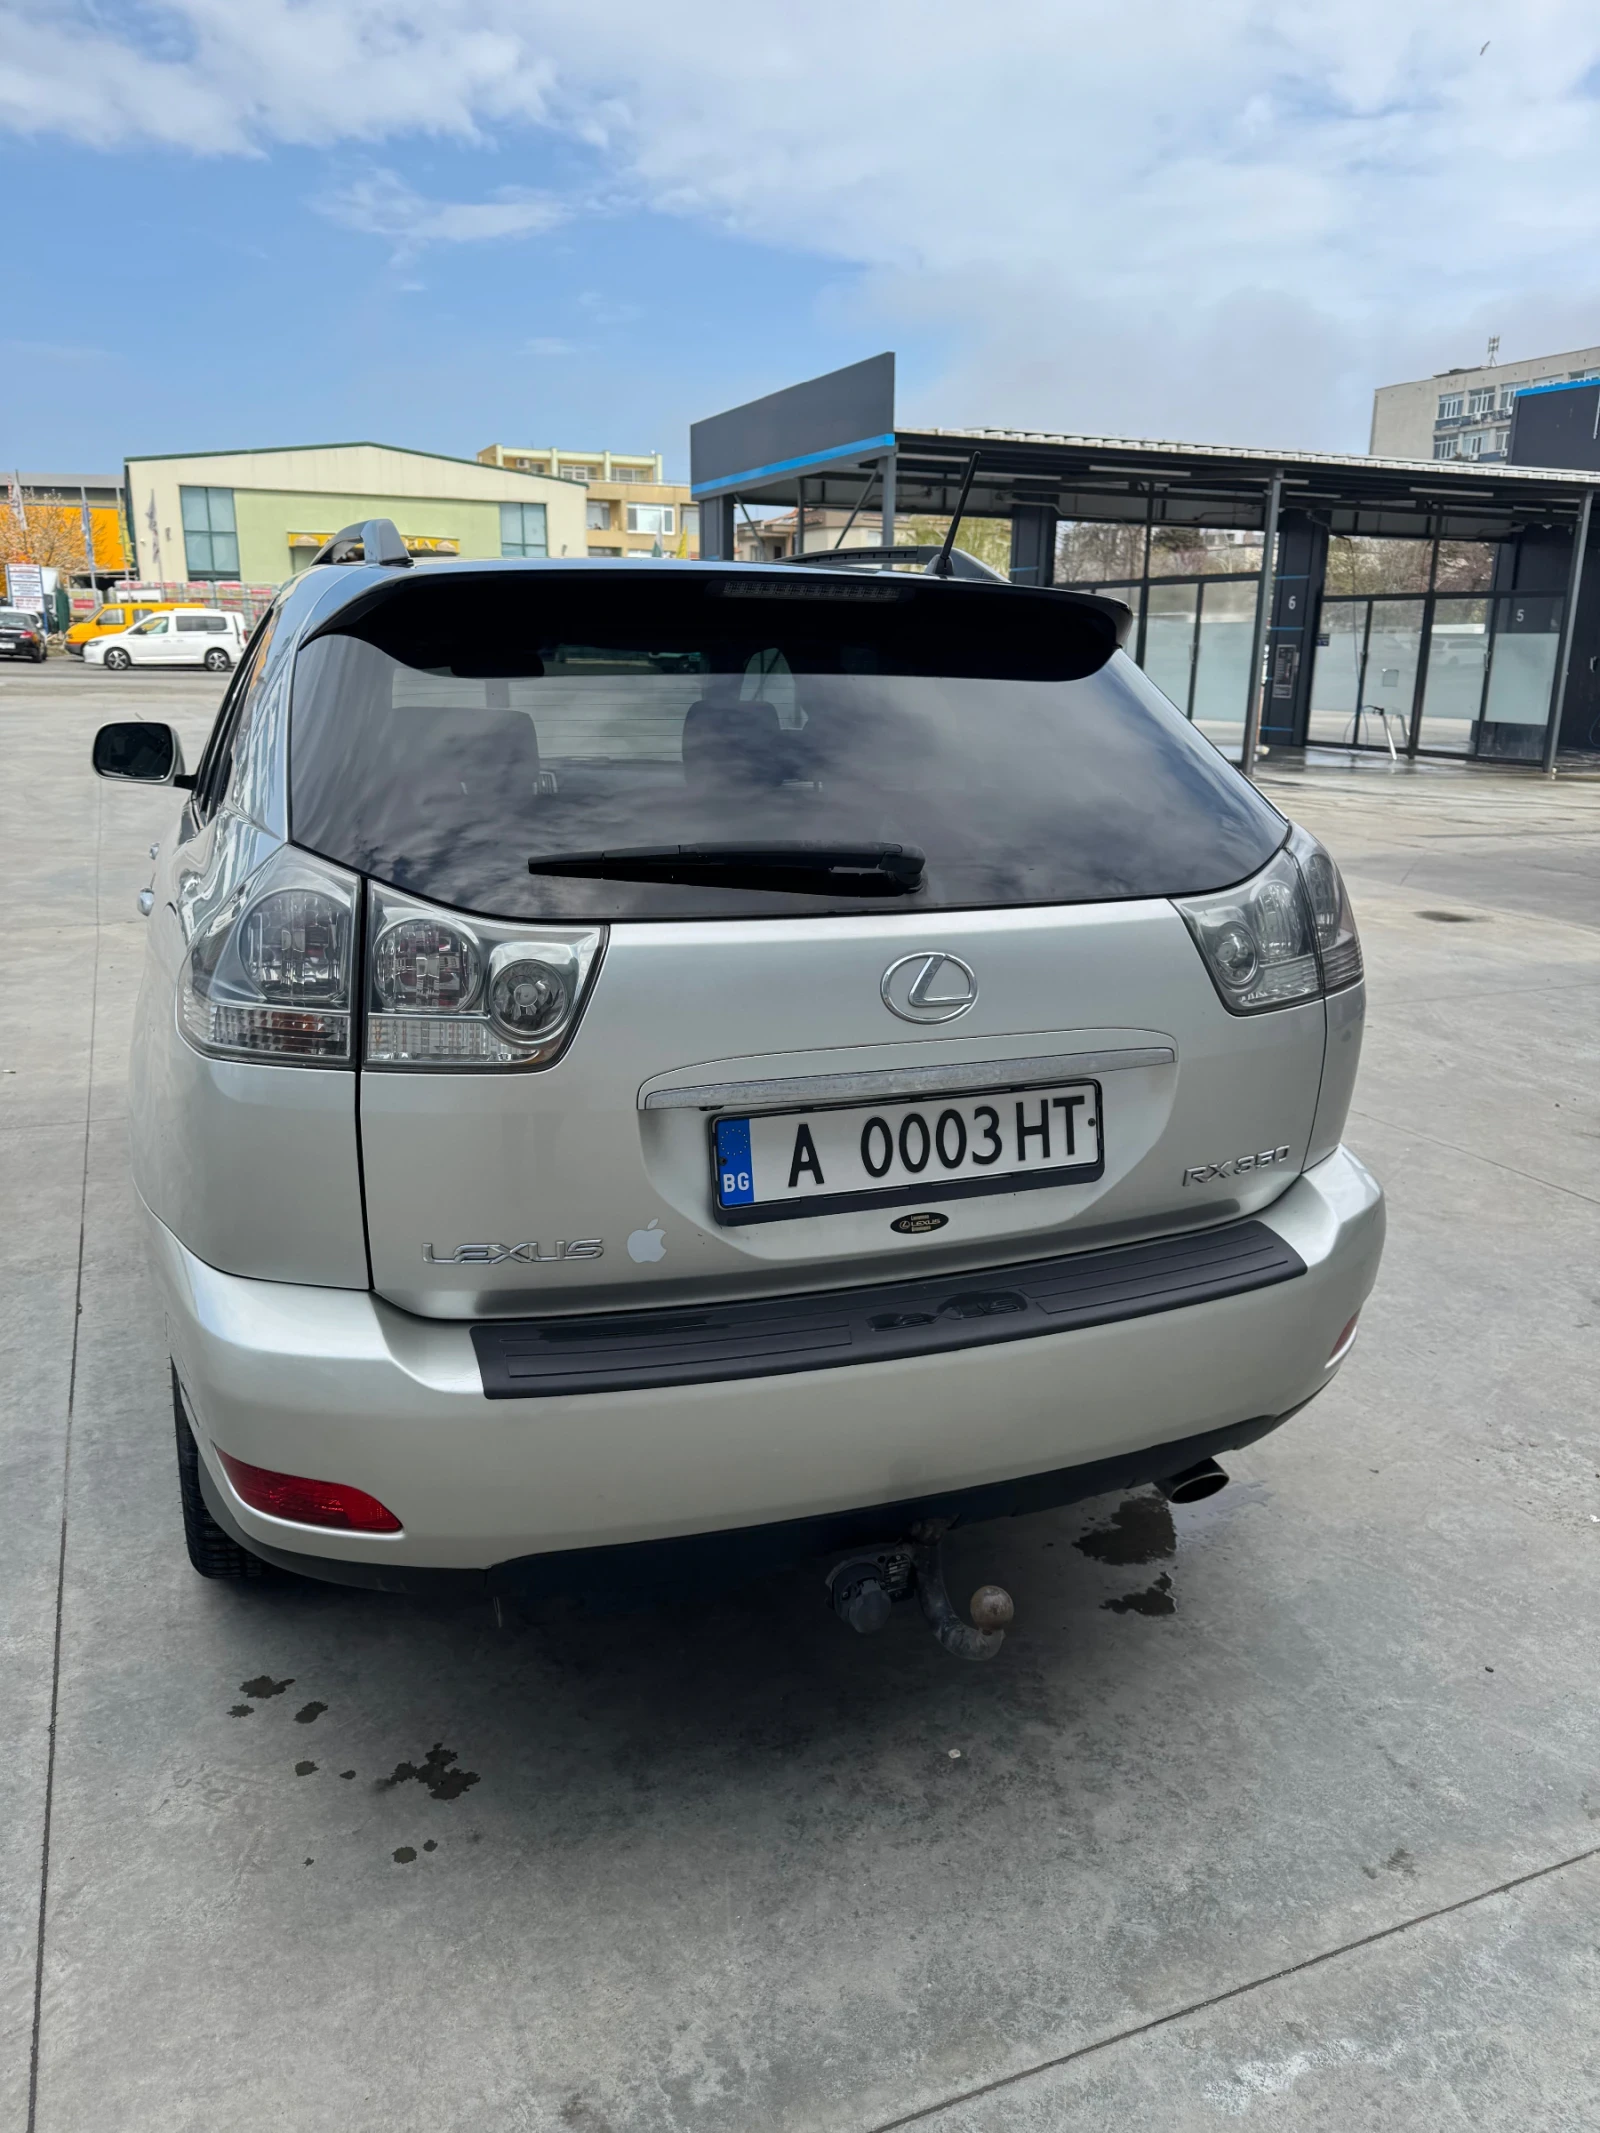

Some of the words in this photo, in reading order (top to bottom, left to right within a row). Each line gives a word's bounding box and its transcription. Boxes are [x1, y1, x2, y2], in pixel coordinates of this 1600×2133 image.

[1288, 595, 1296, 610] 6
[1516, 608, 1525, 622] 5
[787, 1122, 825, 1188] A
[1182, 1160, 1232, 1187] RX
[1234, 1144, 1291, 1175] 350
[723, 1171, 750, 1193] BG
[911, 1218, 941, 1226] LEXUS
[422, 1238, 604, 1265] LEXUS
